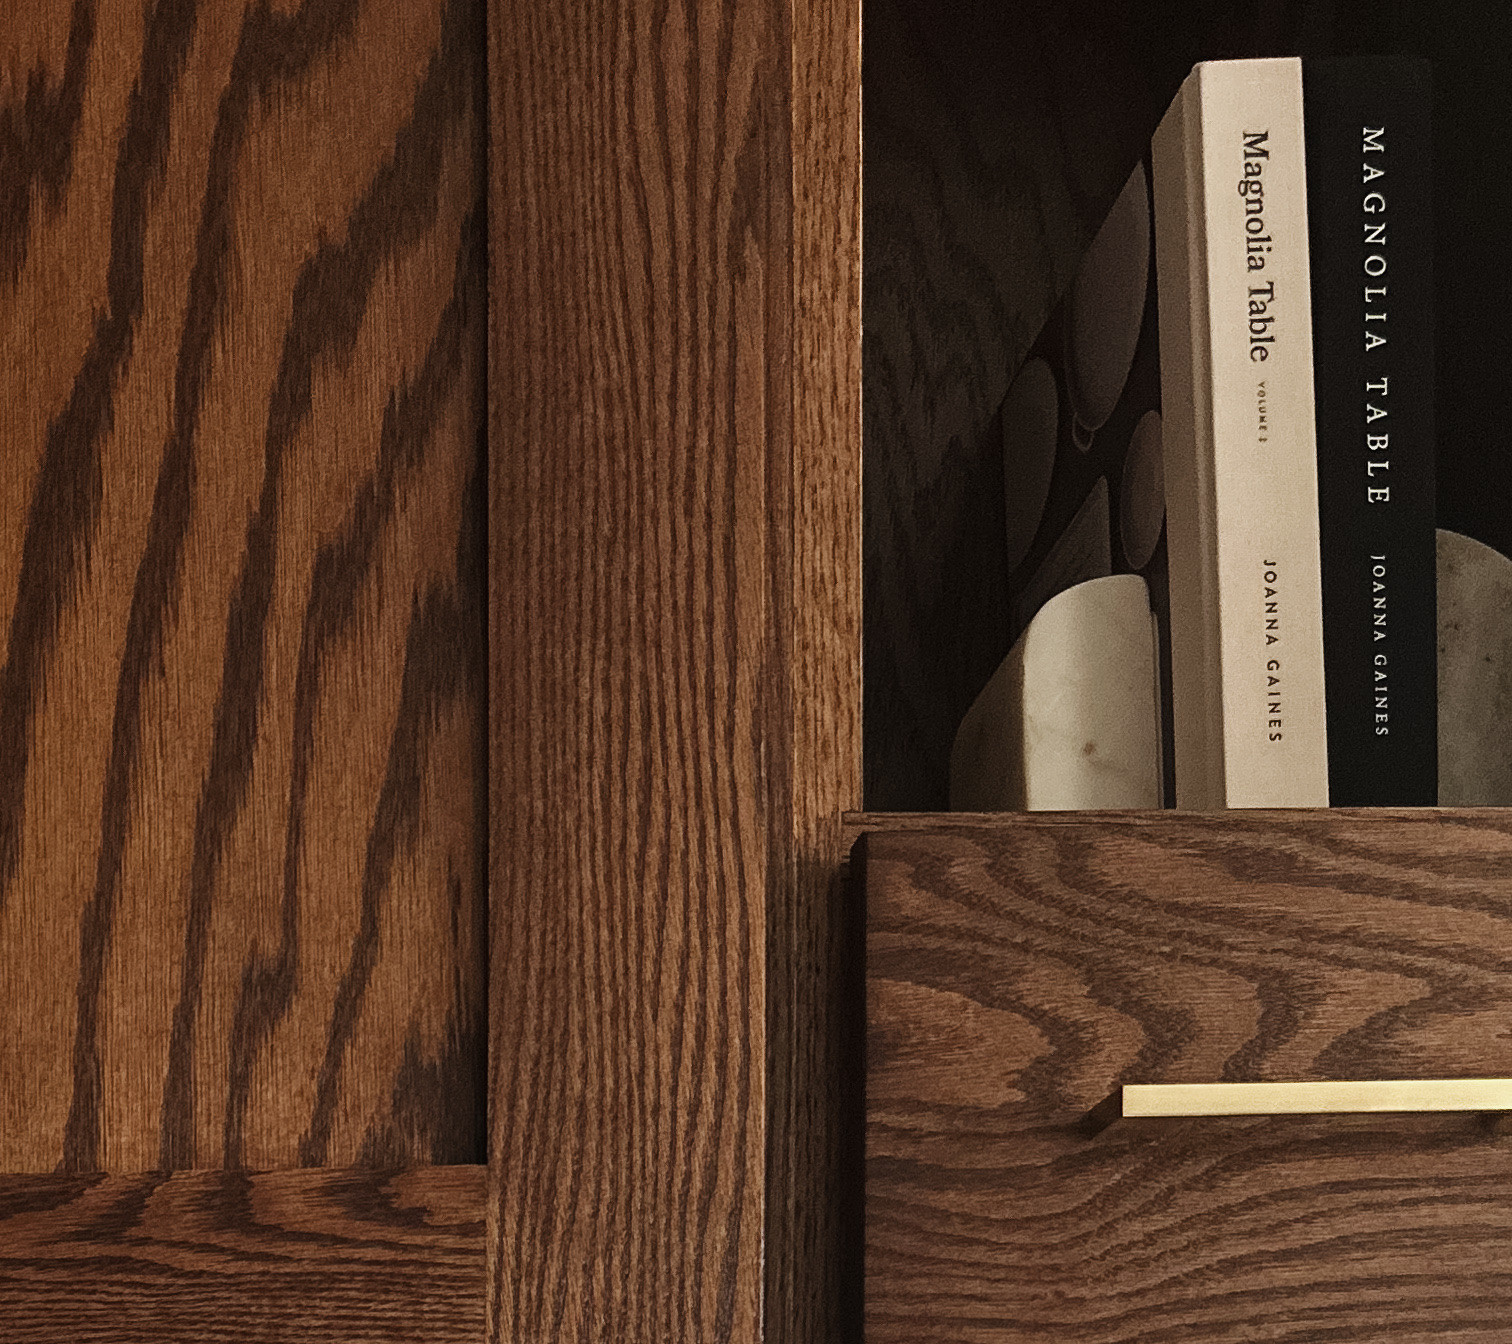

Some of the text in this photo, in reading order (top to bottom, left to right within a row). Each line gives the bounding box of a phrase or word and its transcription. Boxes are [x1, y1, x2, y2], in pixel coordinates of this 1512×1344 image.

[1238, 130, 1272, 273] Magnolia
[1248, 281, 1276, 362] Table
[1363, 126, 1390, 503] MAGNOLIA TABLE
[1257, 381, 1267, 431] VOLUME
[1263, 559, 1282, 742] JOANNA GAINES
[1370, 555, 1388, 735] JOANNA GAINES
